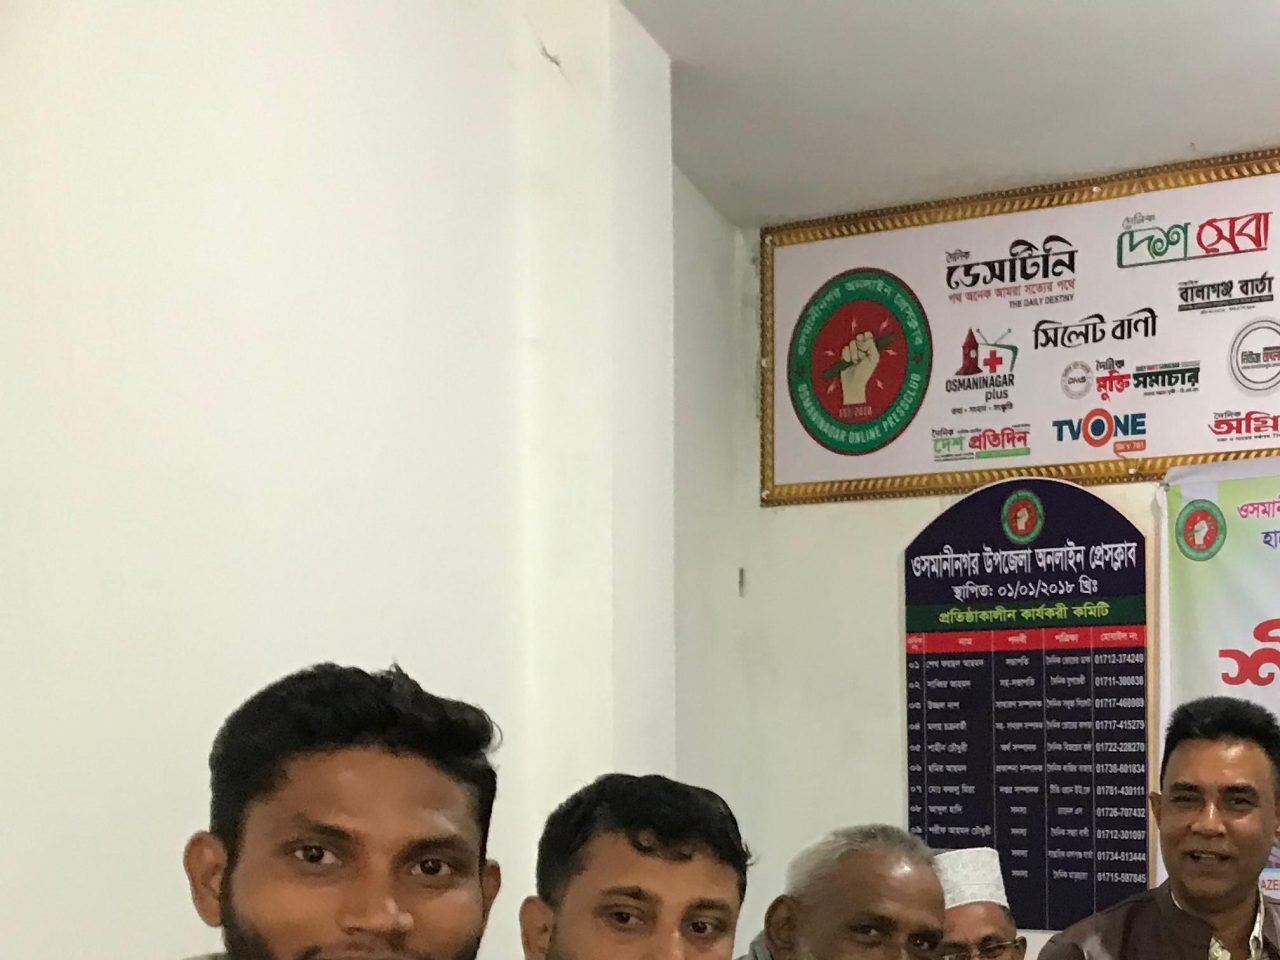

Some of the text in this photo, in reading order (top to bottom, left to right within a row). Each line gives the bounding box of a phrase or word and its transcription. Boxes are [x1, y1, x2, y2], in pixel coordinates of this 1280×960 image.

[944, 235, 1079, 290] ডেসটিনি
[1238, 271, 1275, 297] বার্তা
[1033, 307, 1158, 350] সিলেট বাণী
[946, 374, 1015, 394] OSMANINAGAR
[1132, 367, 1200, 389] সমাচার
[984, 389, 1009, 403] plus
[968, 426, 1030, 450] প্রতিদিন
[911, 538, 1138, 580] ওসমানীনগর উপজেলা অনলাইন প্রেসক্লাব
[997, 579, 1075, 599] ০১/০১/২০১৮
[938, 605, 1017, 624] প্রতিষ্ঠাকালীন
[1072, 600, 1110, 619] কমিটি
